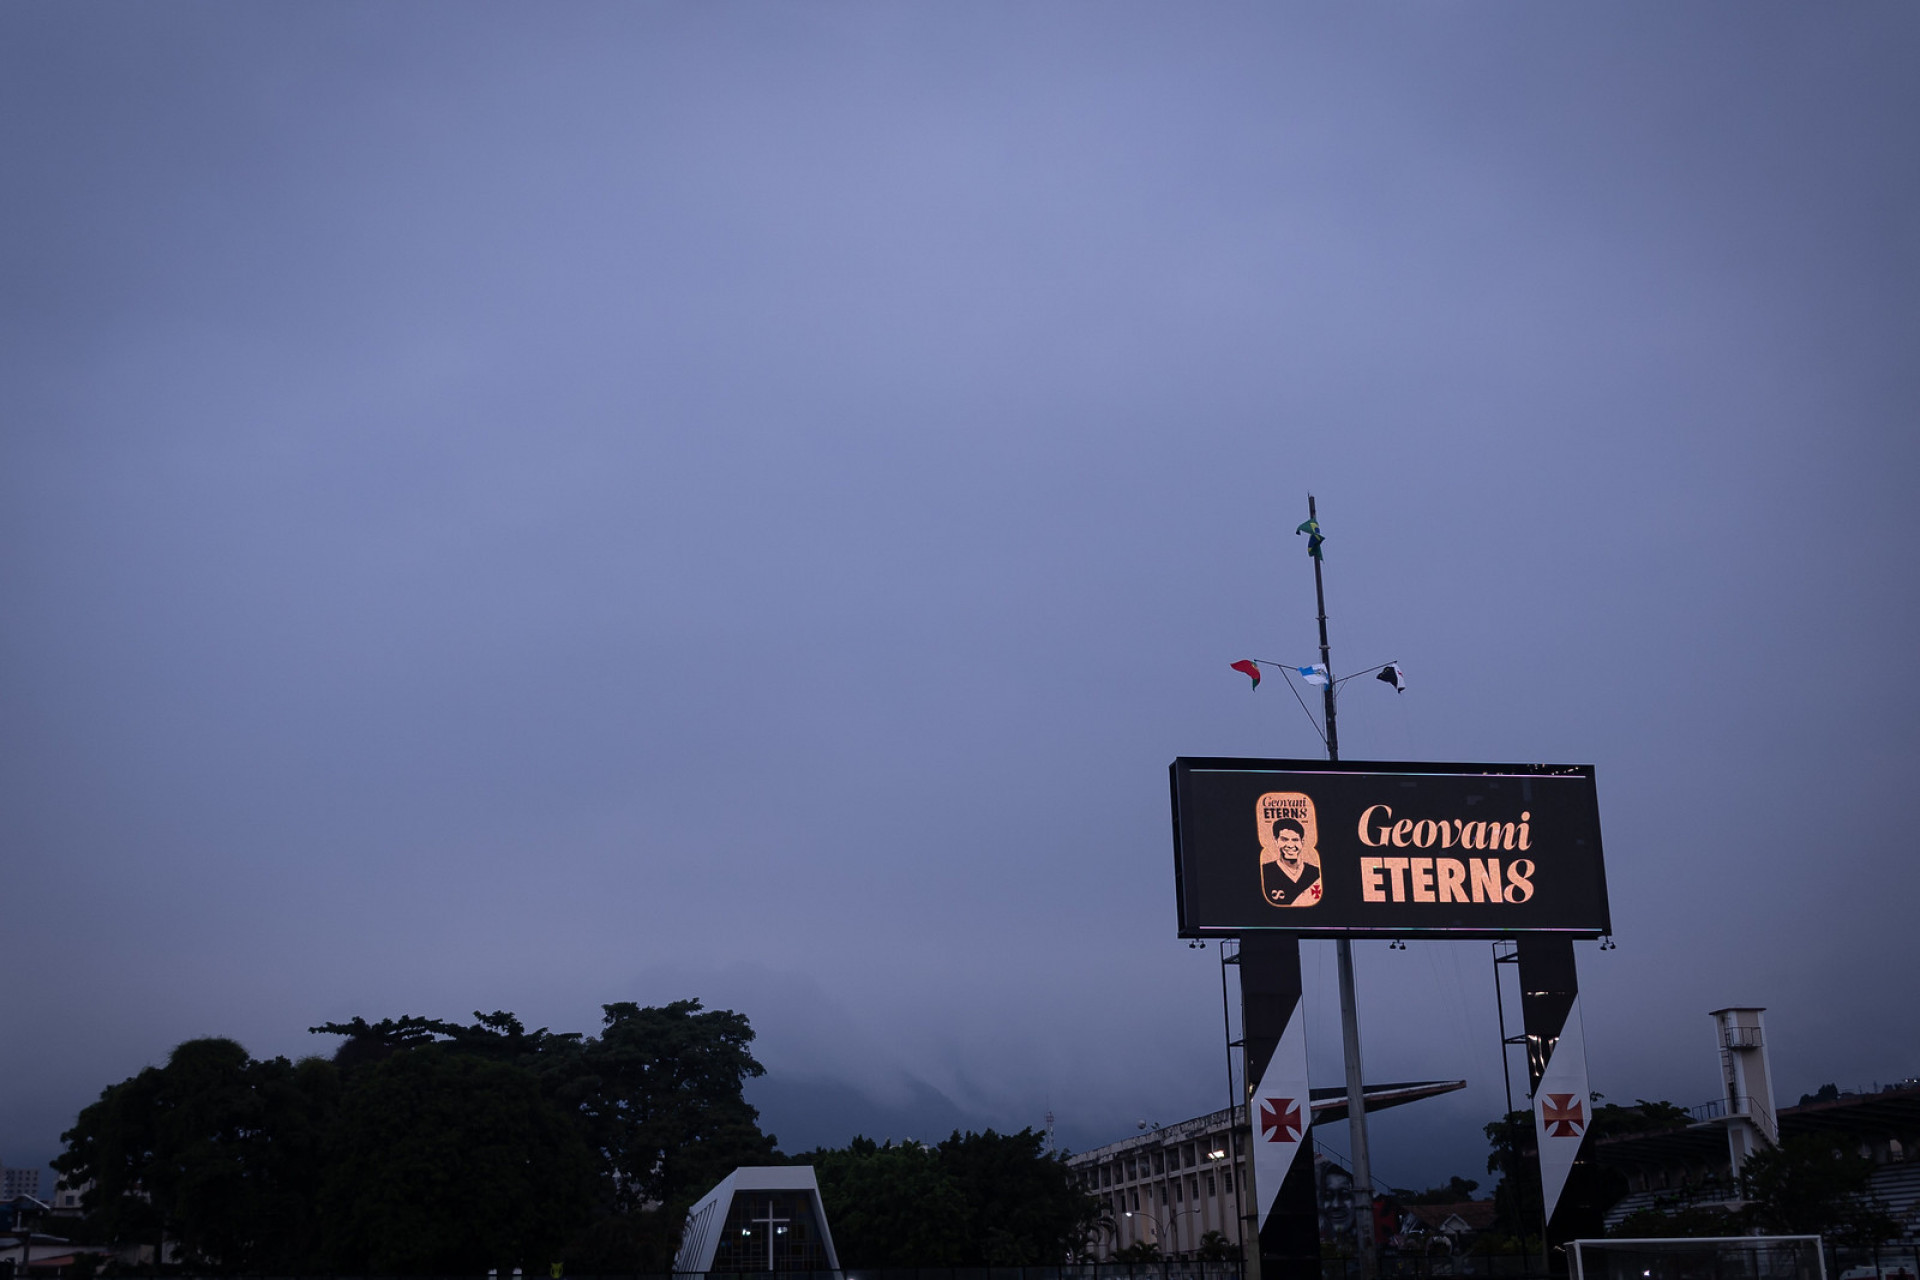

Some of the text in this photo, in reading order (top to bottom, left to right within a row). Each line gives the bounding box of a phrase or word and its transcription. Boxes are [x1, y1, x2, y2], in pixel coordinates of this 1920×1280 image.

[1263, 797, 1307, 807] Geovani
[1264, 808, 1307, 819] ETERN8
[1358, 804, 1532, 851] Geovani
[1360, 857, 1535, 903] ETERN8
